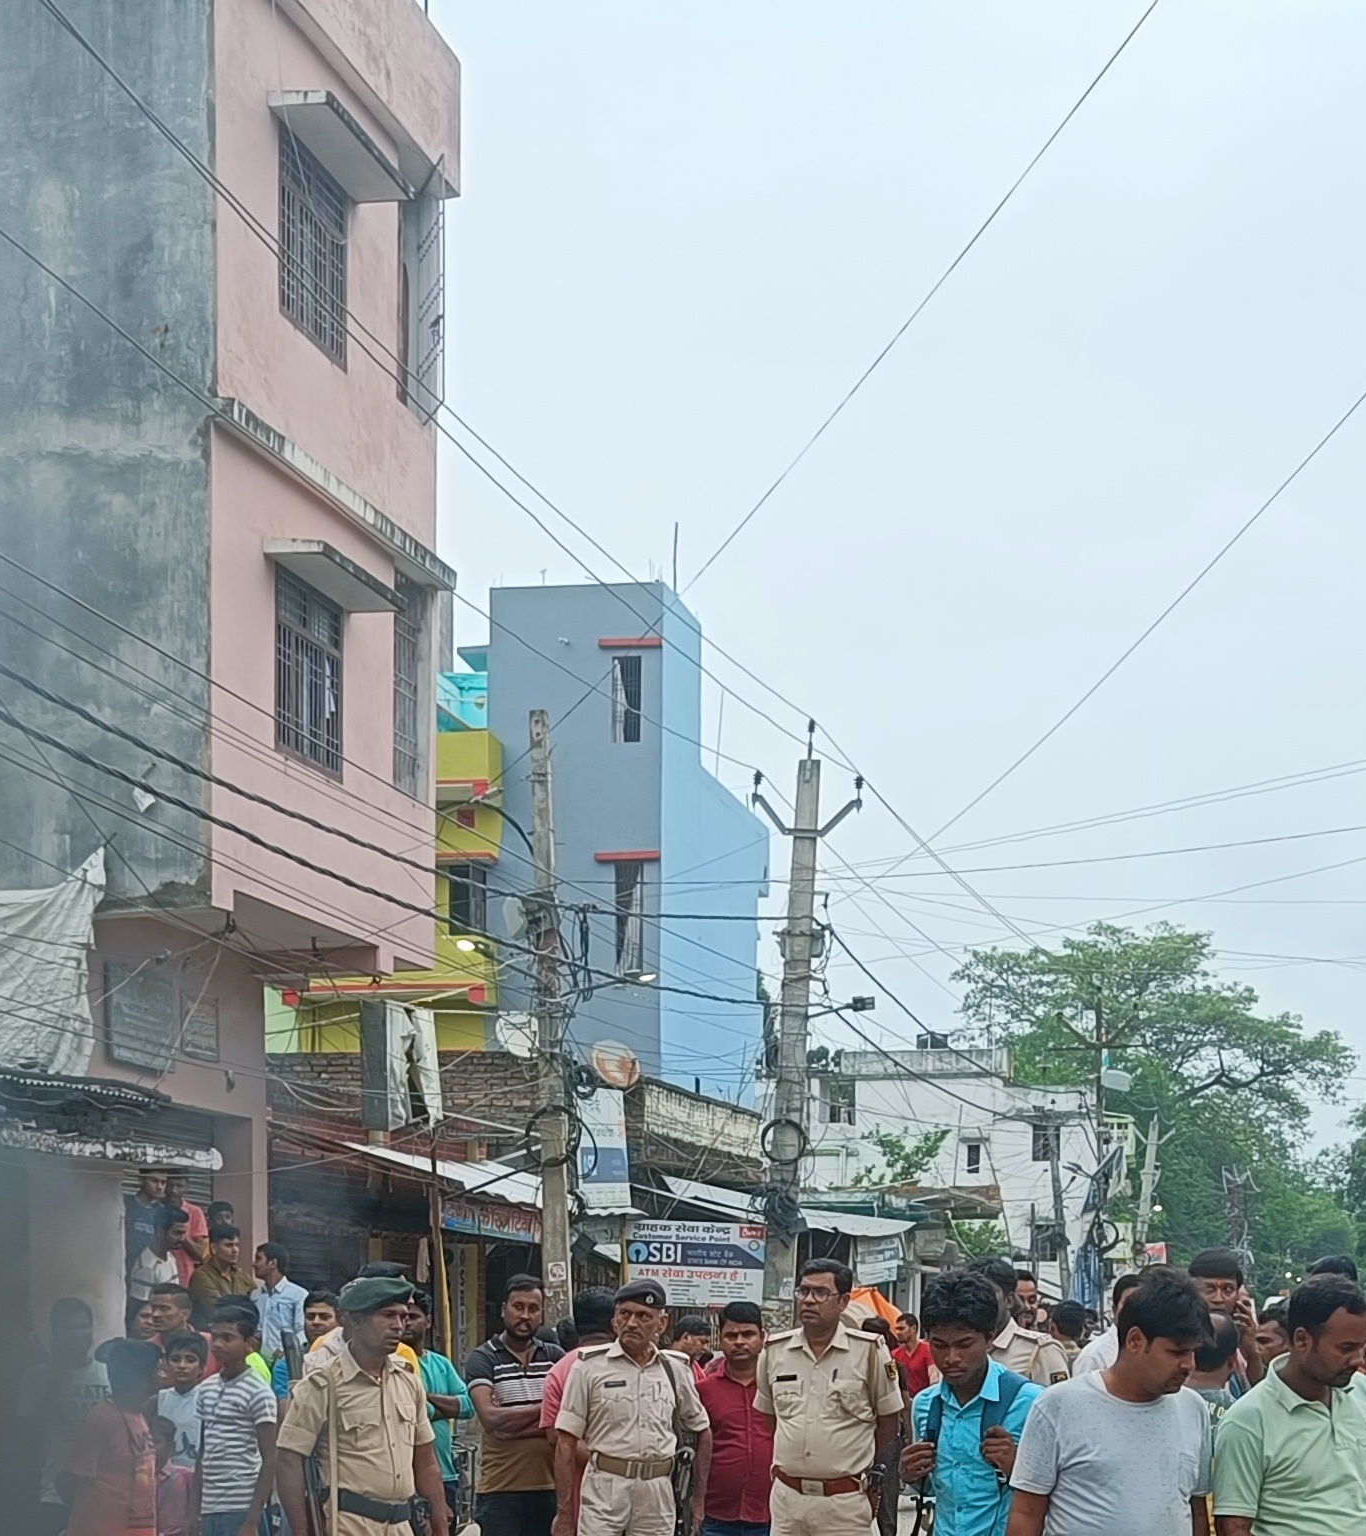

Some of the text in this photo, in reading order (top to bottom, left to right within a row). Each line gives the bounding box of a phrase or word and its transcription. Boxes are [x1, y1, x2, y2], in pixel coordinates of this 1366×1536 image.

[633, 1223, 671, 1233] ग्राहक
[675, 1223, 699, 1234] सेवा
[632, 1231, 730, 1243] Customer Service Point
[648, 1242, 682, 1263] SBI
[637, 1268, 659, 1277] ATM
[662, 1267, 684, 1279] सेवा
